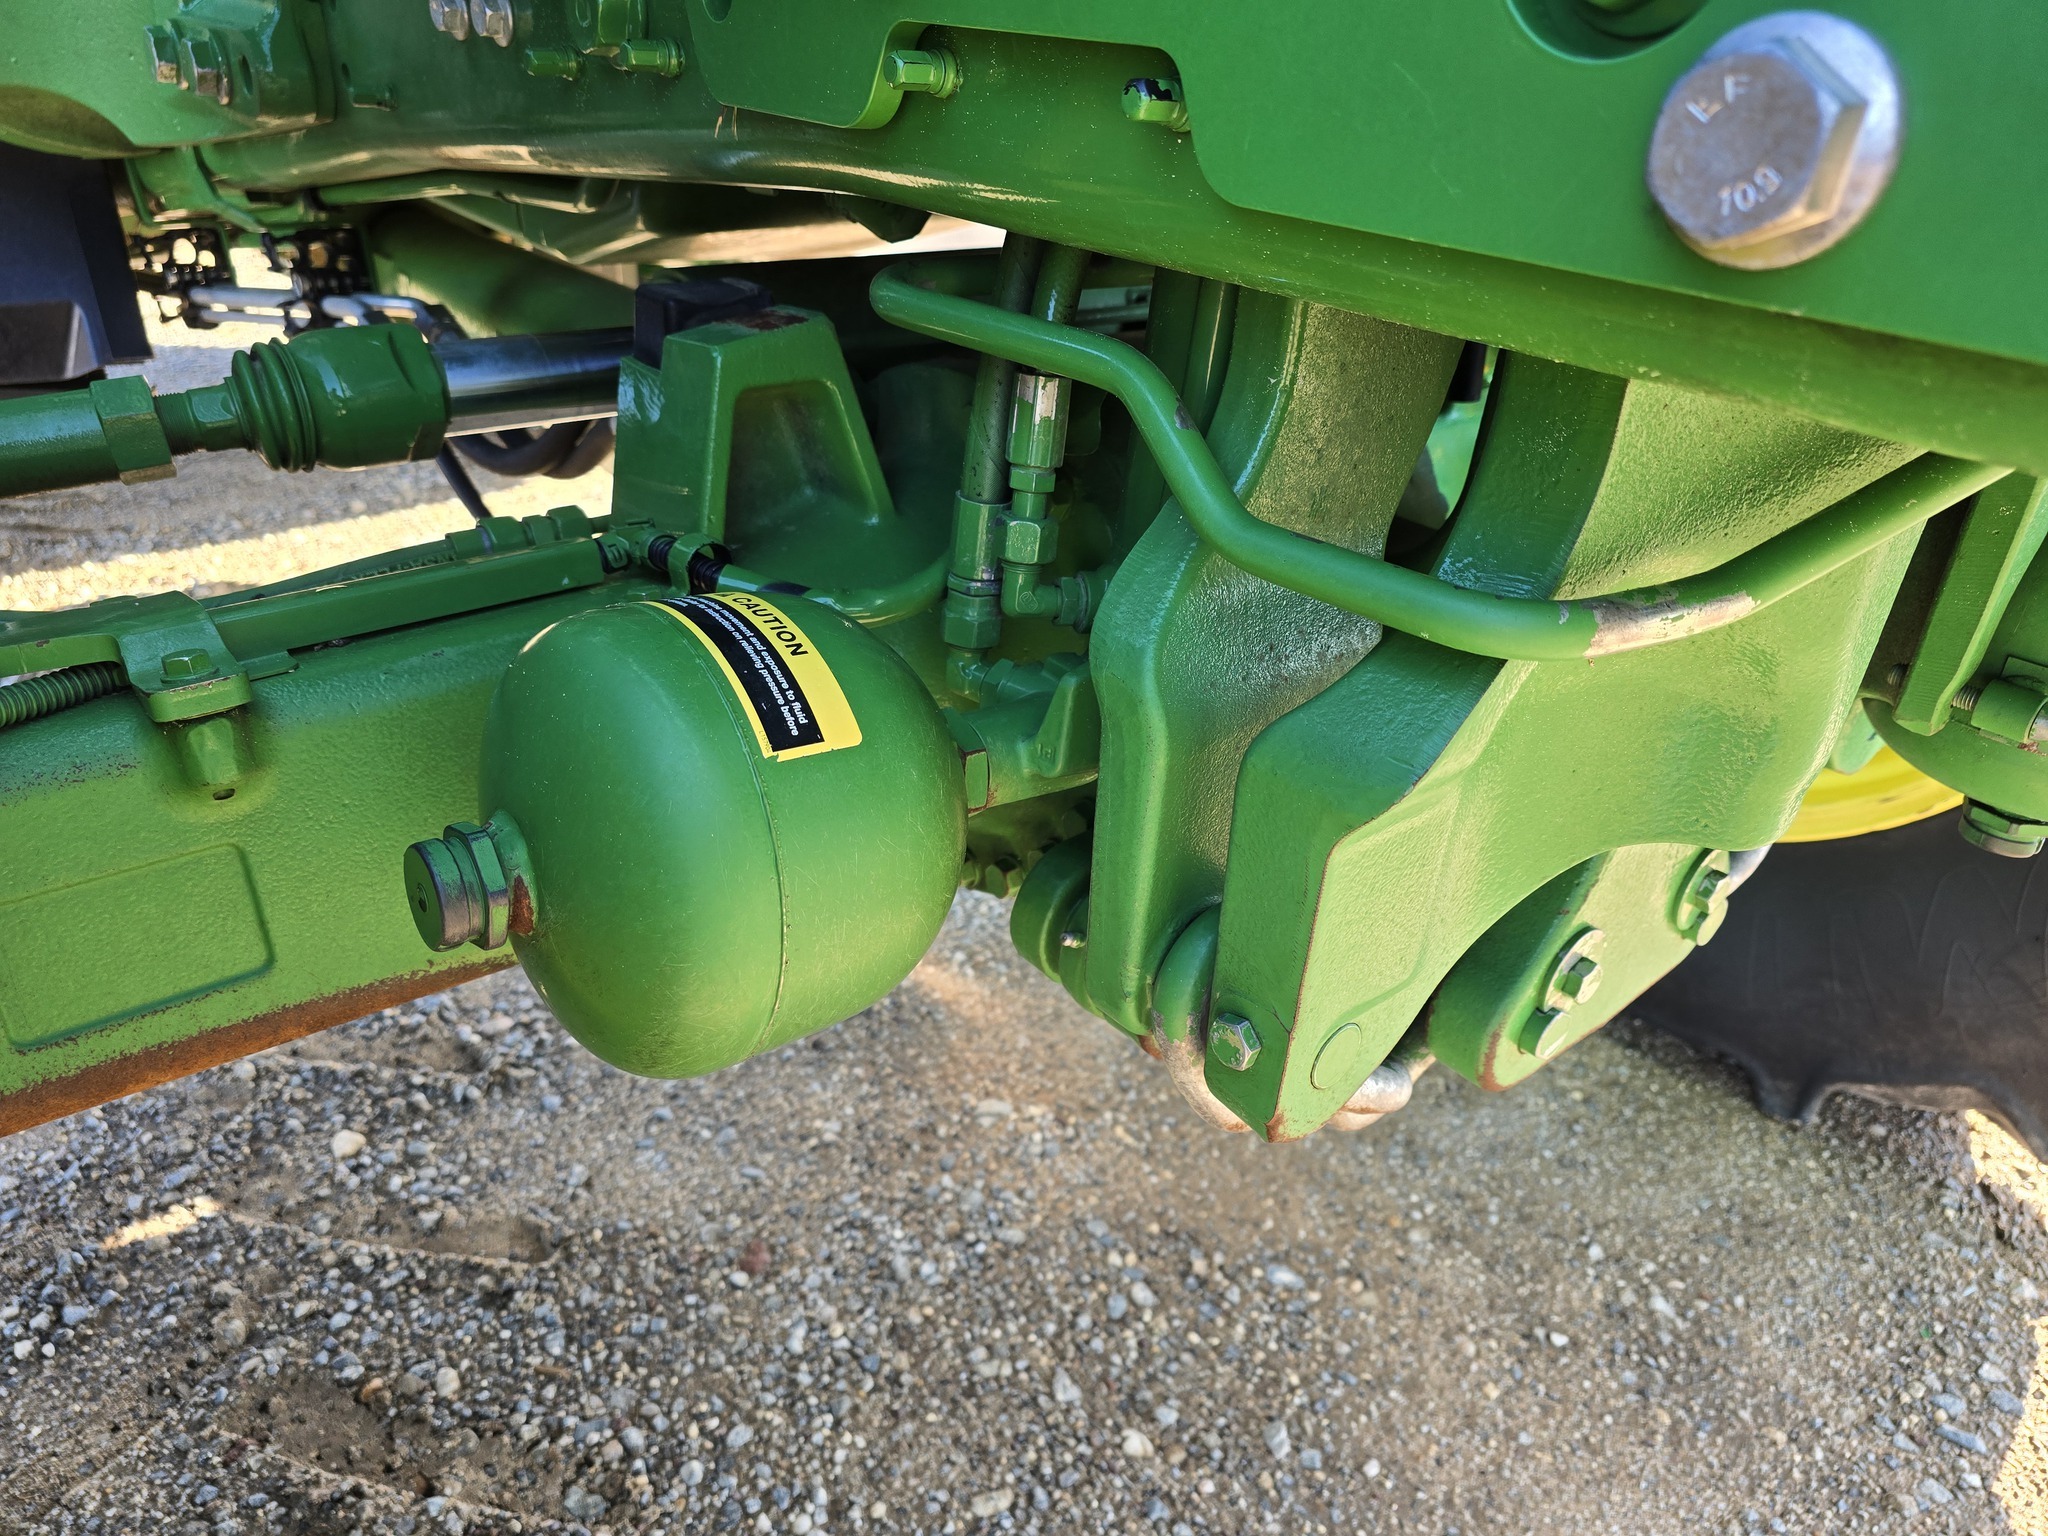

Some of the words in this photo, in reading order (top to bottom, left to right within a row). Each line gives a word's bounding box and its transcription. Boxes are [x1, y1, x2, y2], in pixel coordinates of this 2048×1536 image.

[1718, 165, 1783, 216] 10.9
[720, 609, 754, 637] movement
[749, 636, 767, 651] and
[762, 650, 789, 689] exposure
[785, 689, 795, 701] to
[792, 701, 809, 725] fluid
[732, 597, 808, 656] CAUTION
[704, 608, 735, 632] instruction
[732, 631, 743, 640] on
[739, 640, 764, 669] relieving
[759, 669, 785, 705] pressure
[780, 705, 799, 736] before
